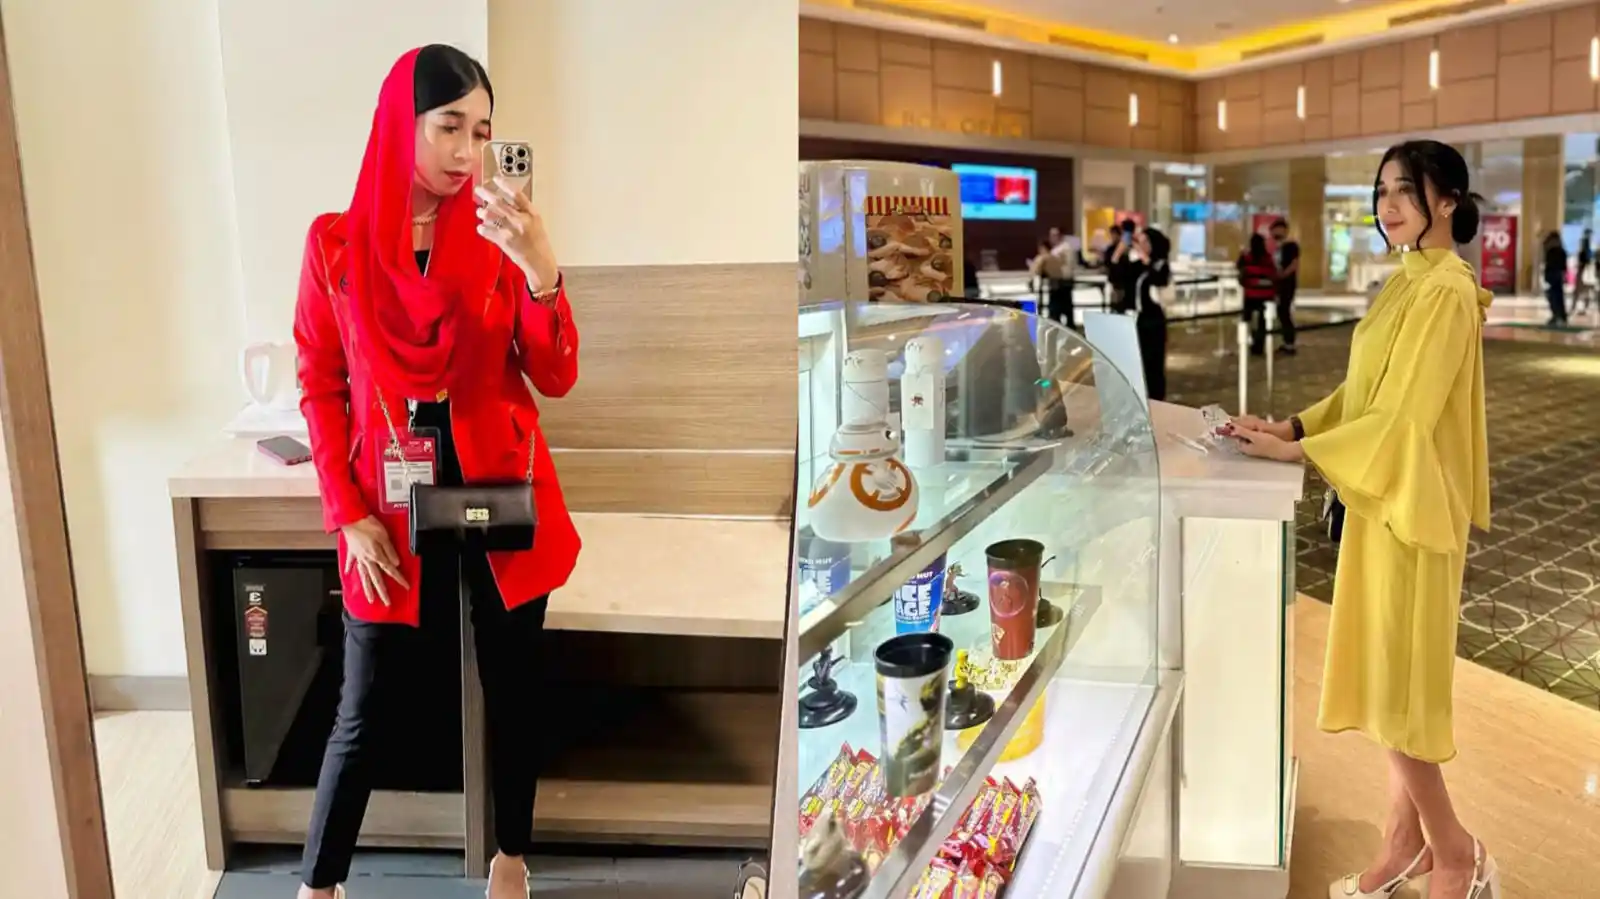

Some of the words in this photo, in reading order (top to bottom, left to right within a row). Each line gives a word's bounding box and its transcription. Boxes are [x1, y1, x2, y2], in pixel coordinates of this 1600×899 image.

[1483, 231, 1511, 250] 70
[895, 583, 931, 601] ICE
[895, 600, 930, 617] AGE
